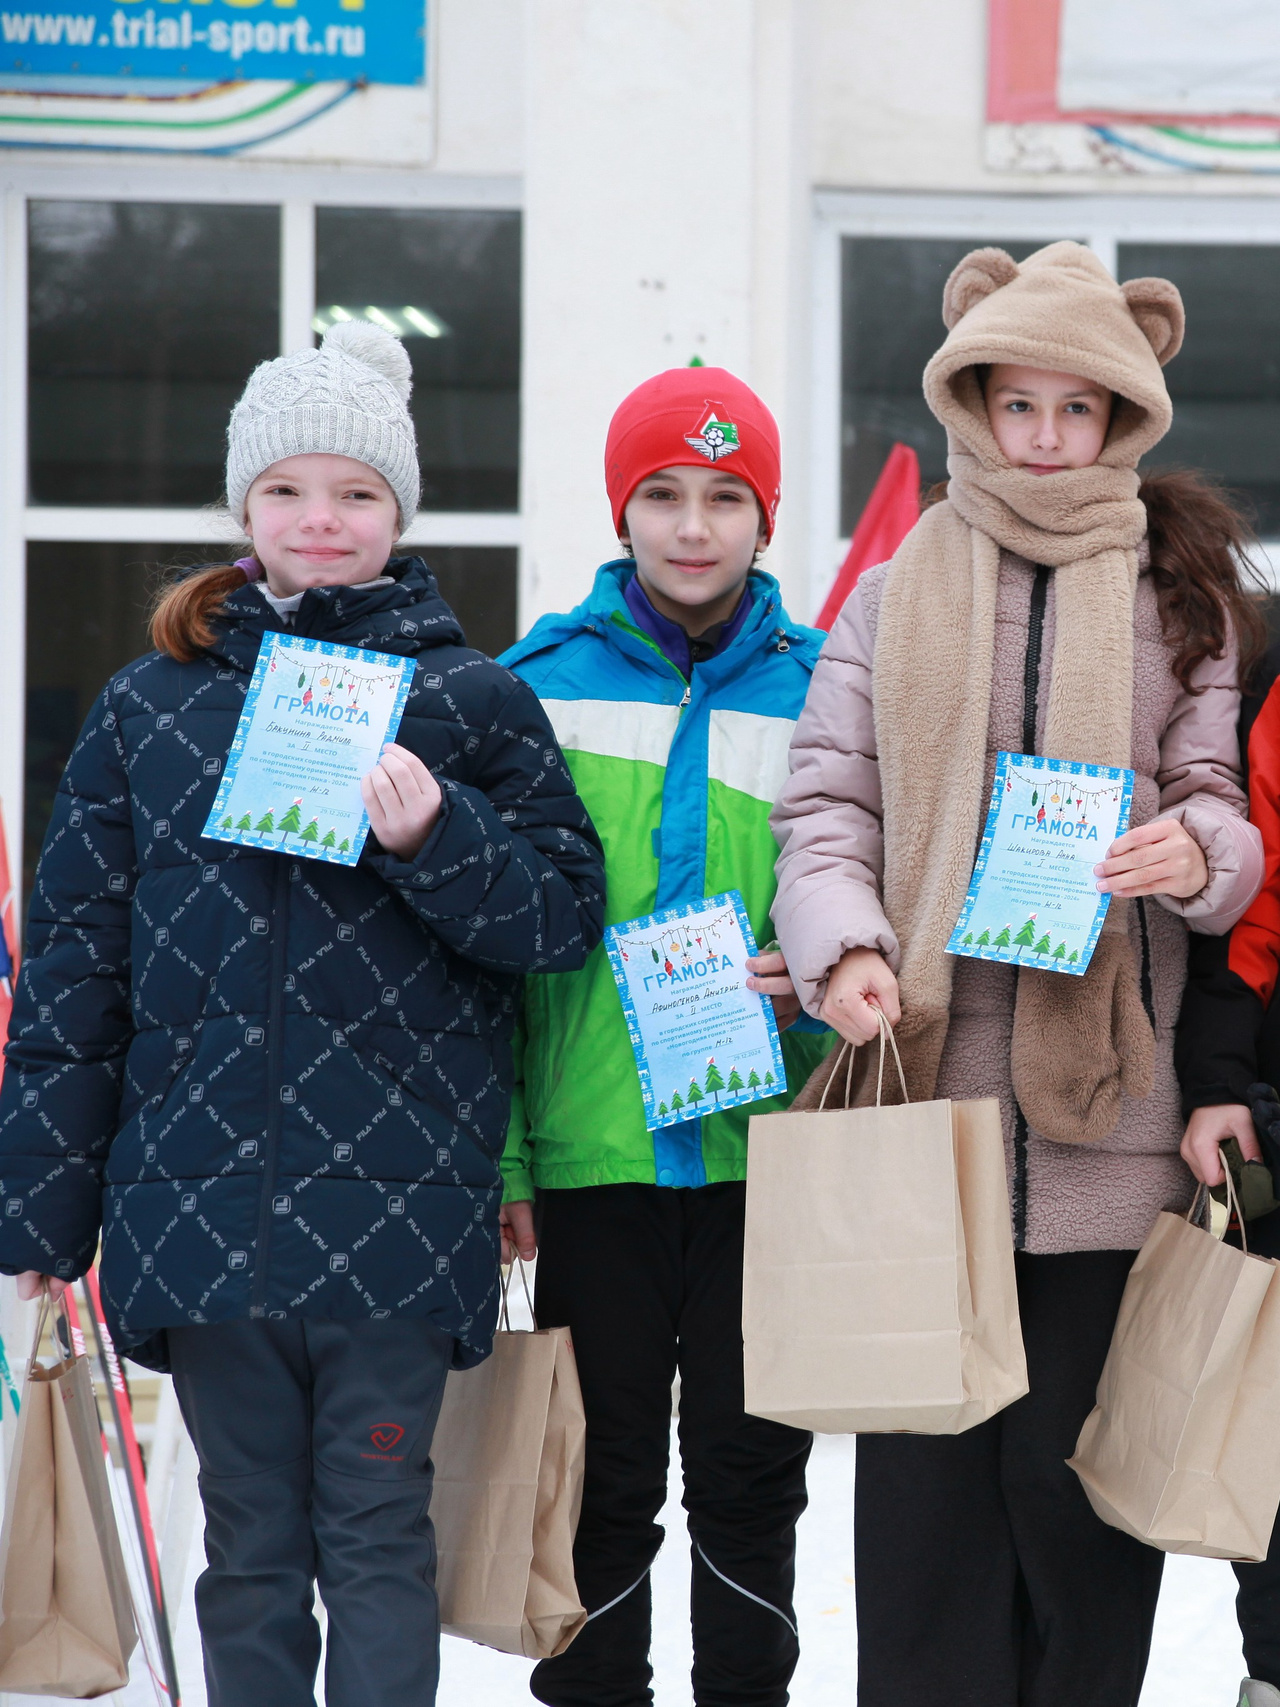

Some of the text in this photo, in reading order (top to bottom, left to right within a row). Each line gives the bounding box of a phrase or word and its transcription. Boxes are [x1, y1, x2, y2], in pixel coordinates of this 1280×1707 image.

[1, 9, 365, 60] www.trial-sport.ru
[273, 694, 370, 727] ГРАМОТА
[294, 718, 344, 732] Награждается
[314, 747, 337, 756] МЕСТО
[258, 758, 305, 771] спортивному
[305, 767, 361, 781] ориентировани
[267, 751, 304, 762] городских
[304, 758, 357, 772] соревнованиях
[282, 783, 306, 791] группе
[320, 808, 350, 818] 29.12.2024
[1011, 813, 1099, 841] ГРАМОТА
[1030, 837, 1075, 848] Награждается
[1048, 864, 1069, 872] МЕСТО
[1006, 870, 1039, 879] городских
[1039, 875, 1088, 886] соревнованиях
[219, 882, 233, 898] FILA
[304, 884, 319, 900] FILA
[998, 877, 1040, 888] спортивному
[1040, 883, 1096, 896] ориентированию
[73, 902, 90, 914] FILA
[234, 897, 249, 913] FILA
[1018, 899, 1041, 907] группе
[170, 906, 185, 923] FILA
[359, 909, 375, 923] FILA
[1052, 922, 1080, 931] 29.12.2024
[230, 936, 247, 952] FILA
[316, 942, 333, 956] FILA
[173, 947, 186, 962] FILA
[357, 946, 370, 964] FILA
[190, 961, 204, 976] FILA
[298, 958, 315, 972] FILA
[642, 954, 734, 992] ГРАМОТА
[403, 973, 416, 987] FILA
[670, 979, 716, 995] Награждается
[55, 989, 71, 1003] FILA
[700, 1001, 722, 1012] МЕСТО
[659, 1028, 702, 1044] спортивному
[702, 1012, 759, 1032] ориентированию
[663, 1021, 697, 1034] городских
[697, 1007, 746, 1025] соревнованиях
[51, 1026, 64, 1043] FILA
[707, 1029, 726, 1038] гонка
[690, 1045, 712, 1055] группе
[733, 1049, 761, 1061] 29.12.2024
[43, 1073, 60, 1088] FILA
[208, 1065, 223, 1081] FILA
[298, 1067, 315, 1083] FILA
[206, 1105, 219, 1122] FILA
[298, 1106, 313, 1123] FILA
[159, 1124, 171, 1140] FILA
[356, 1125, 372, 1141] FILA
[29, 1182, 45, 1197] FILA
[24, 1220, 38, 1238] FILA
[197, 1215, 210, 1232] FILA
[294, 1216, 310, 1233] FILA
[407, 1218, 420, 1235] FILA
[353, 1235, 369, 1251] FILA
